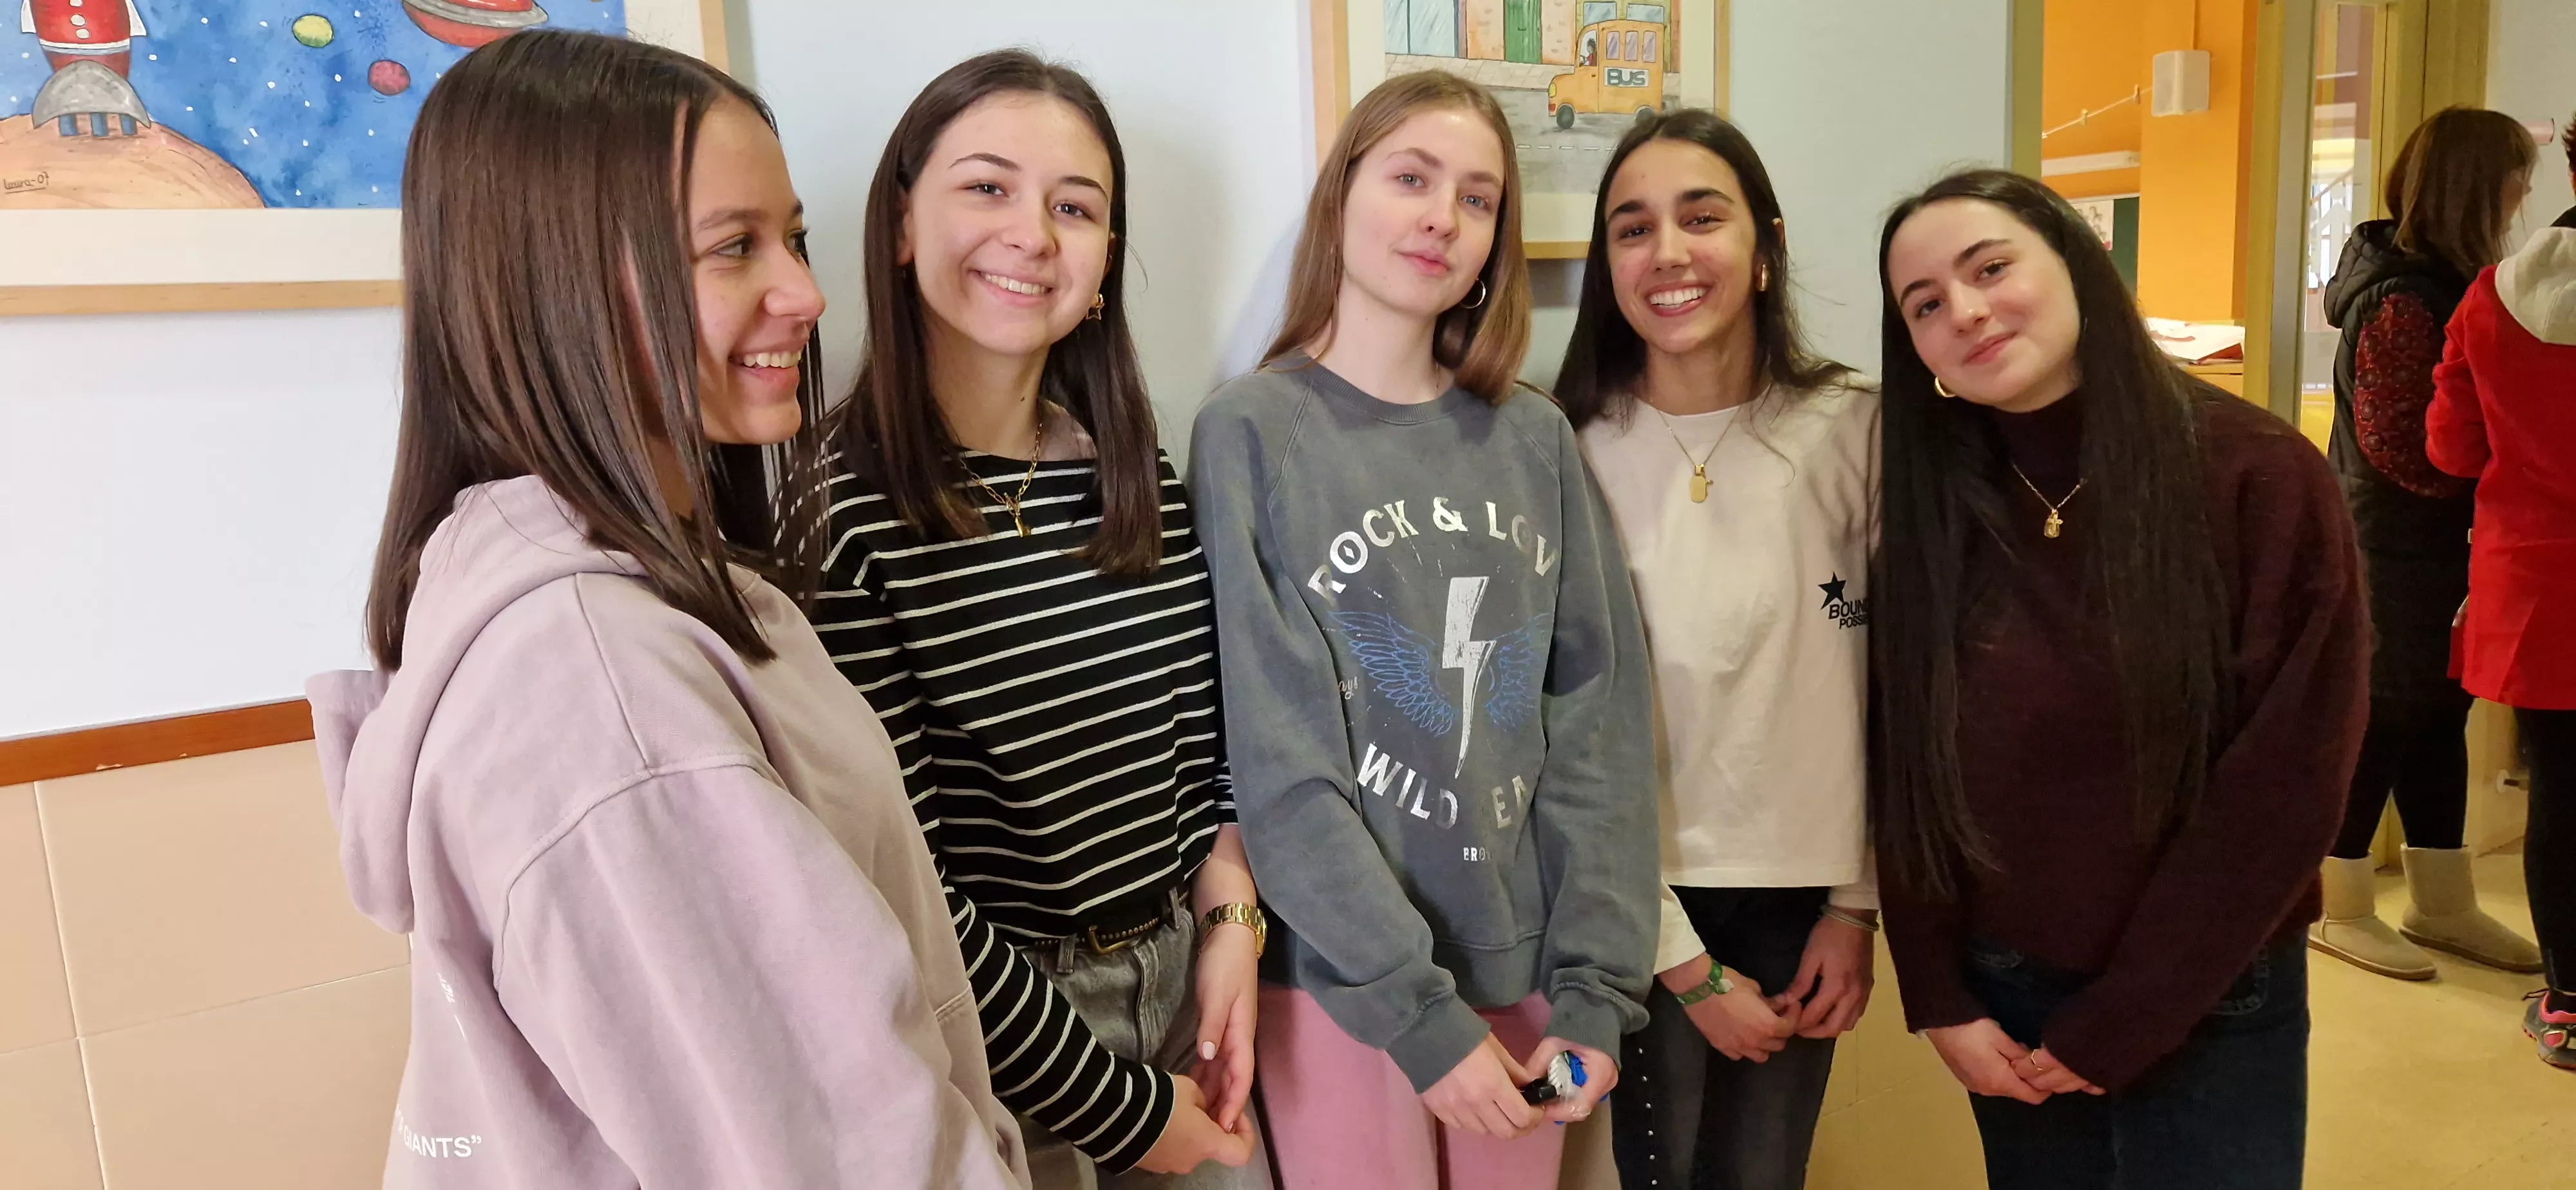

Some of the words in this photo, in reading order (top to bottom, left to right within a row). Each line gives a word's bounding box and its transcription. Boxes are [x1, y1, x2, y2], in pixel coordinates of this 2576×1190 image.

[1607, 68, 1646, 86] BUS
[1307, 499, 1419, 607] ROCK
[1432, 496, 1468, 533] &
[1356, 742, 1459, 830] WILD
